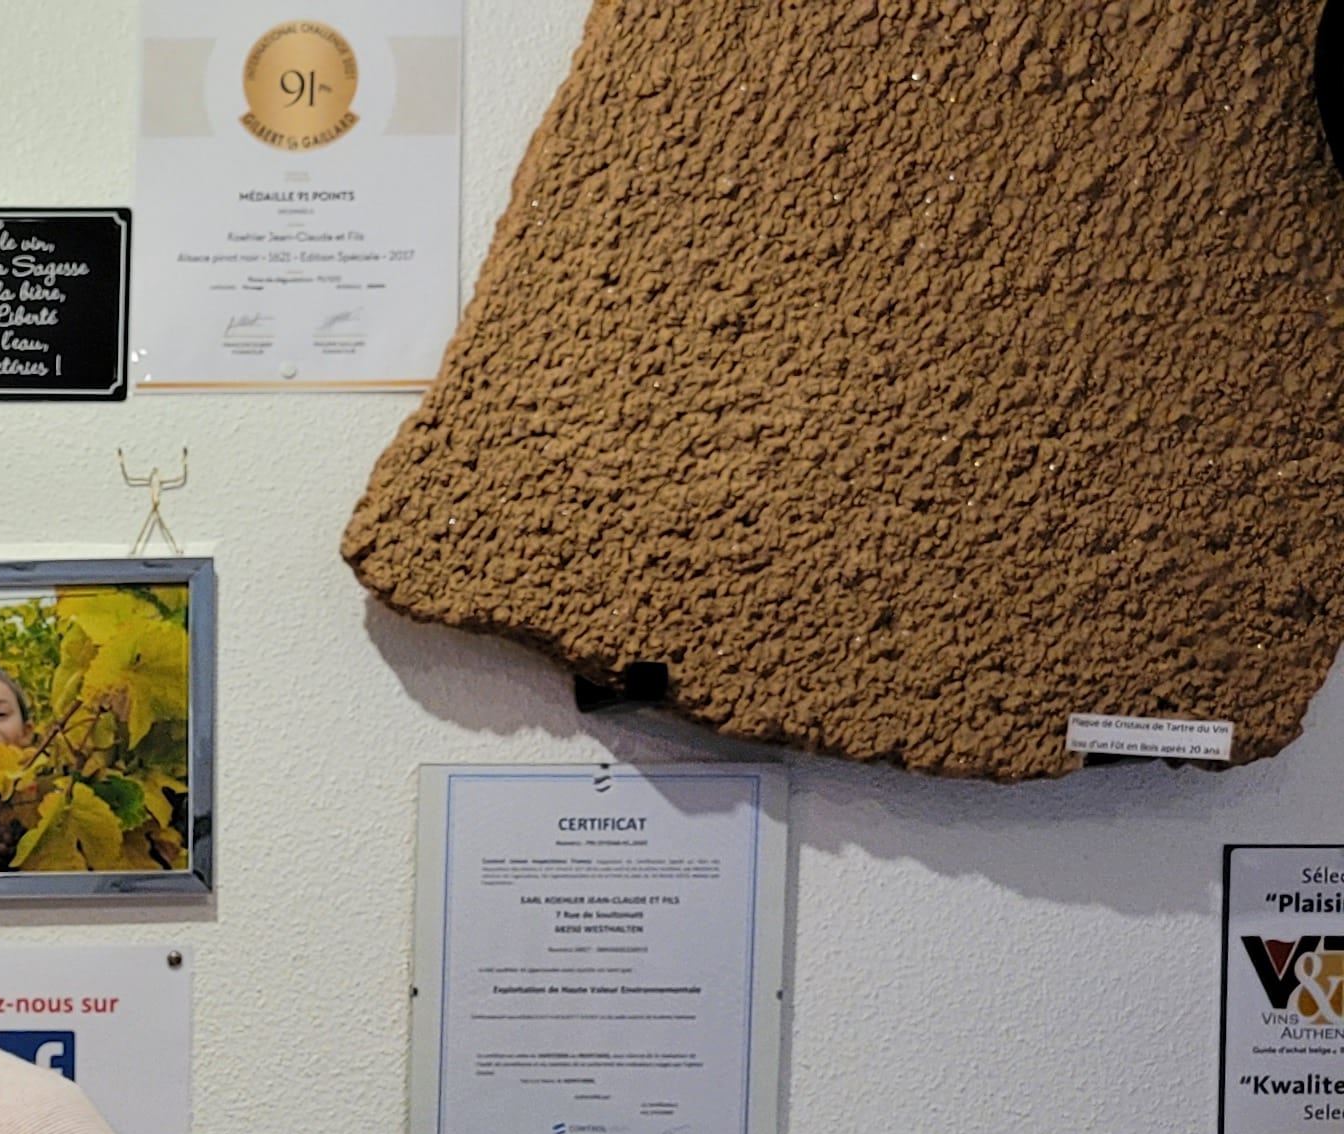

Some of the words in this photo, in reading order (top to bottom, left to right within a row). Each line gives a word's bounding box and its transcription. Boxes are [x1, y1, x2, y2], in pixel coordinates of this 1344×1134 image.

[280, 70, 315, 108] 91
[243, 112, 284, 146] GILBERT
[302, 112, 354, 148] GAILLARD
[239, 190, 295, 202] MÉDAILLE
[312, 192, 355, 202] POINTS
[0, 230, 17, 251] le
[21, 236, 55, 253] vin,
[12, 255, 90, 286] Sagesse
[19, 280, 66, 303] bière,
[1072, 717, 1099, 728] Plaque
[1101, 719, 1112, 728] de
[1115, 720, 1150, 730] Cristaux
[1152, 721, 1164, 731] de
[1167, 722, 1193, 732] Tartre
[1196, 724, 1210, 733] du
[1212, 725, 1229, 734] Vin
[1188, 745, 1201, 754] 20
[1203, 747, 1220, 755] ans
[558, 818, 647, 831] CERTIFICAT
[81, 997, 119, 1013] sur
